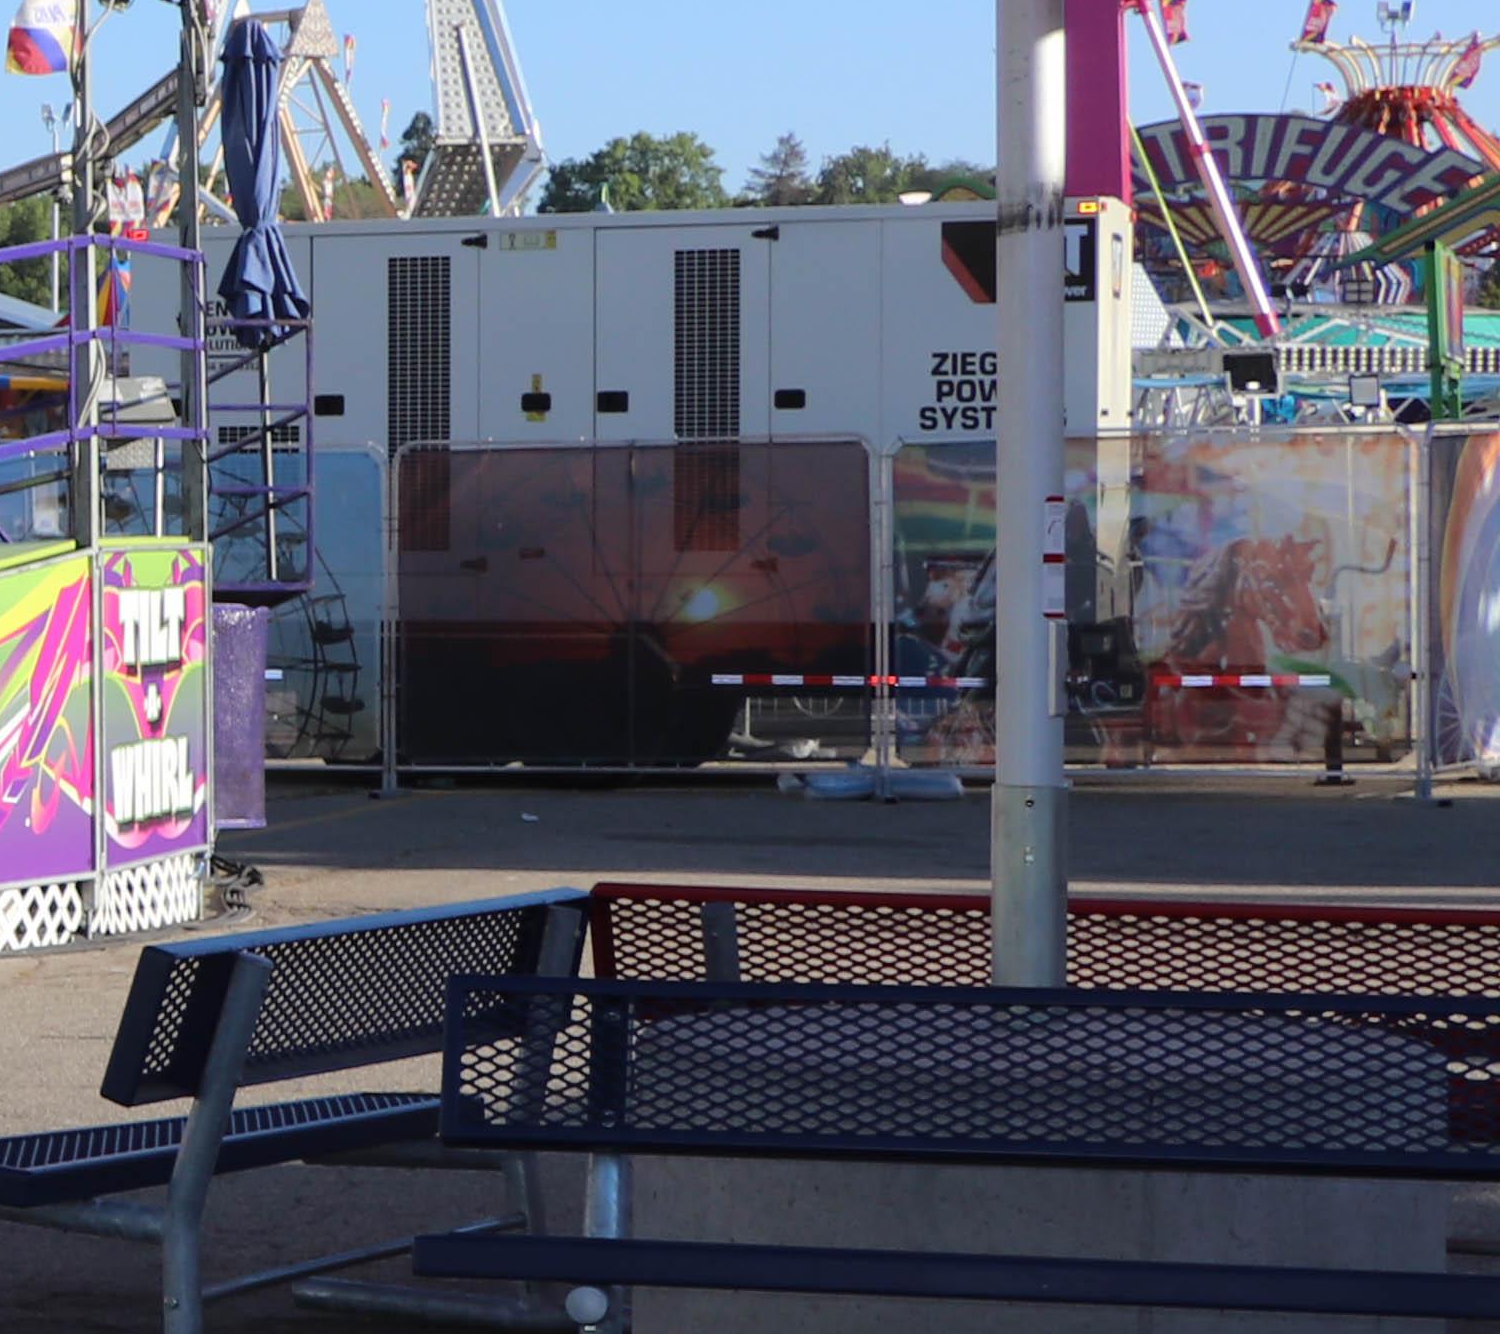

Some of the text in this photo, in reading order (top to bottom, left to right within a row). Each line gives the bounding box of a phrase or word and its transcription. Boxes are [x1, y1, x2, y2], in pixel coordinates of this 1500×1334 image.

[1131, 116, 1484, 217] TRIFUGE
[931, 352, 997, 376] ZIEG
[936, 379, 997, 403] POW
[119, 587, 185, 667] TILT
[144, 682, 163, 723] A
[111, 736, 193, 825] WHIRL
